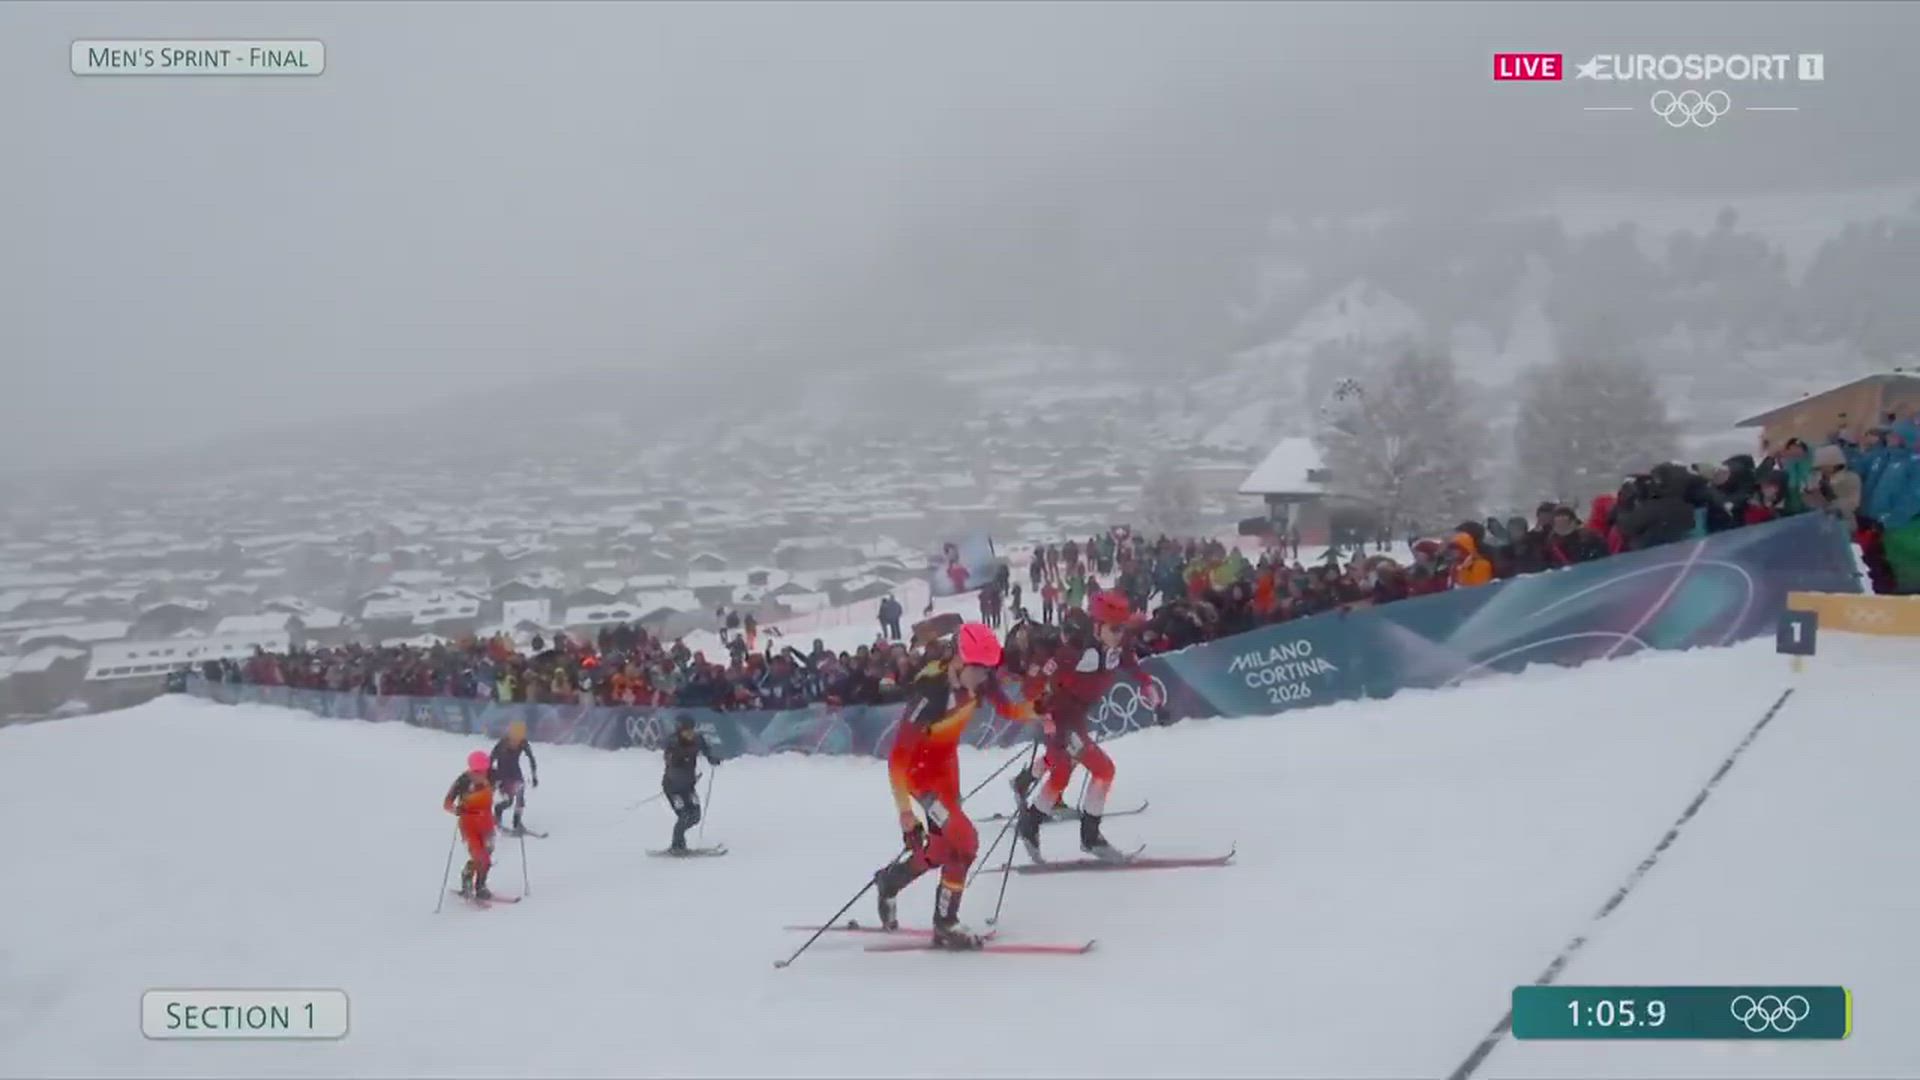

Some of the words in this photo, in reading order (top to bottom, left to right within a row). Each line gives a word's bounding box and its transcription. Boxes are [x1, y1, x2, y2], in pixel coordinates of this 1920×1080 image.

[1790, 621, 1802, 643] 1
[1227, 640, 1312, 674] MILANO
[1245, 657, 1339, 688] CORTINA
[1267, 681, 1311, 704] 2026
